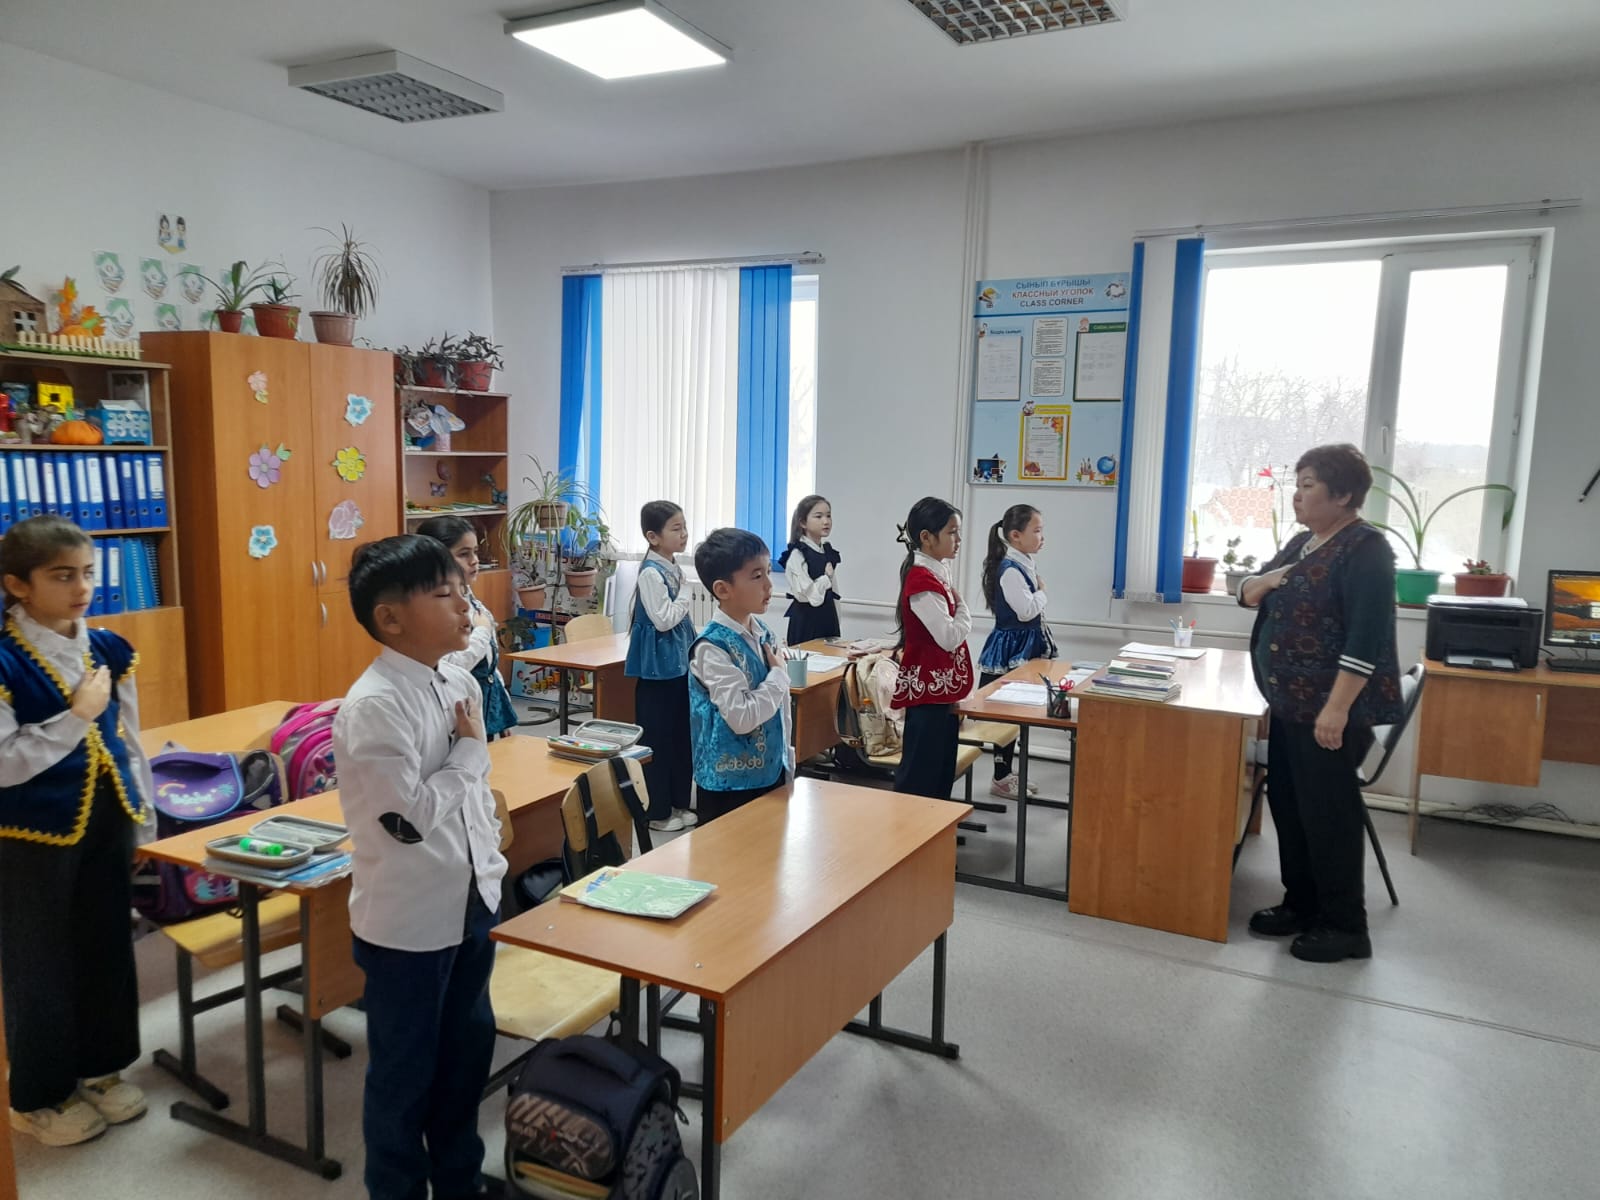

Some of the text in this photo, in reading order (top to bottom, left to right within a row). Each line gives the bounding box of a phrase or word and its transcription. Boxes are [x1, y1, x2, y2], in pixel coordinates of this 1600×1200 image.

[1016, 280, 1048, 289] СЫНЫП
[1061, 287, 1094, 296] УГОЛОК
[1020, 297, 1084, 307] CLASS CORNER
